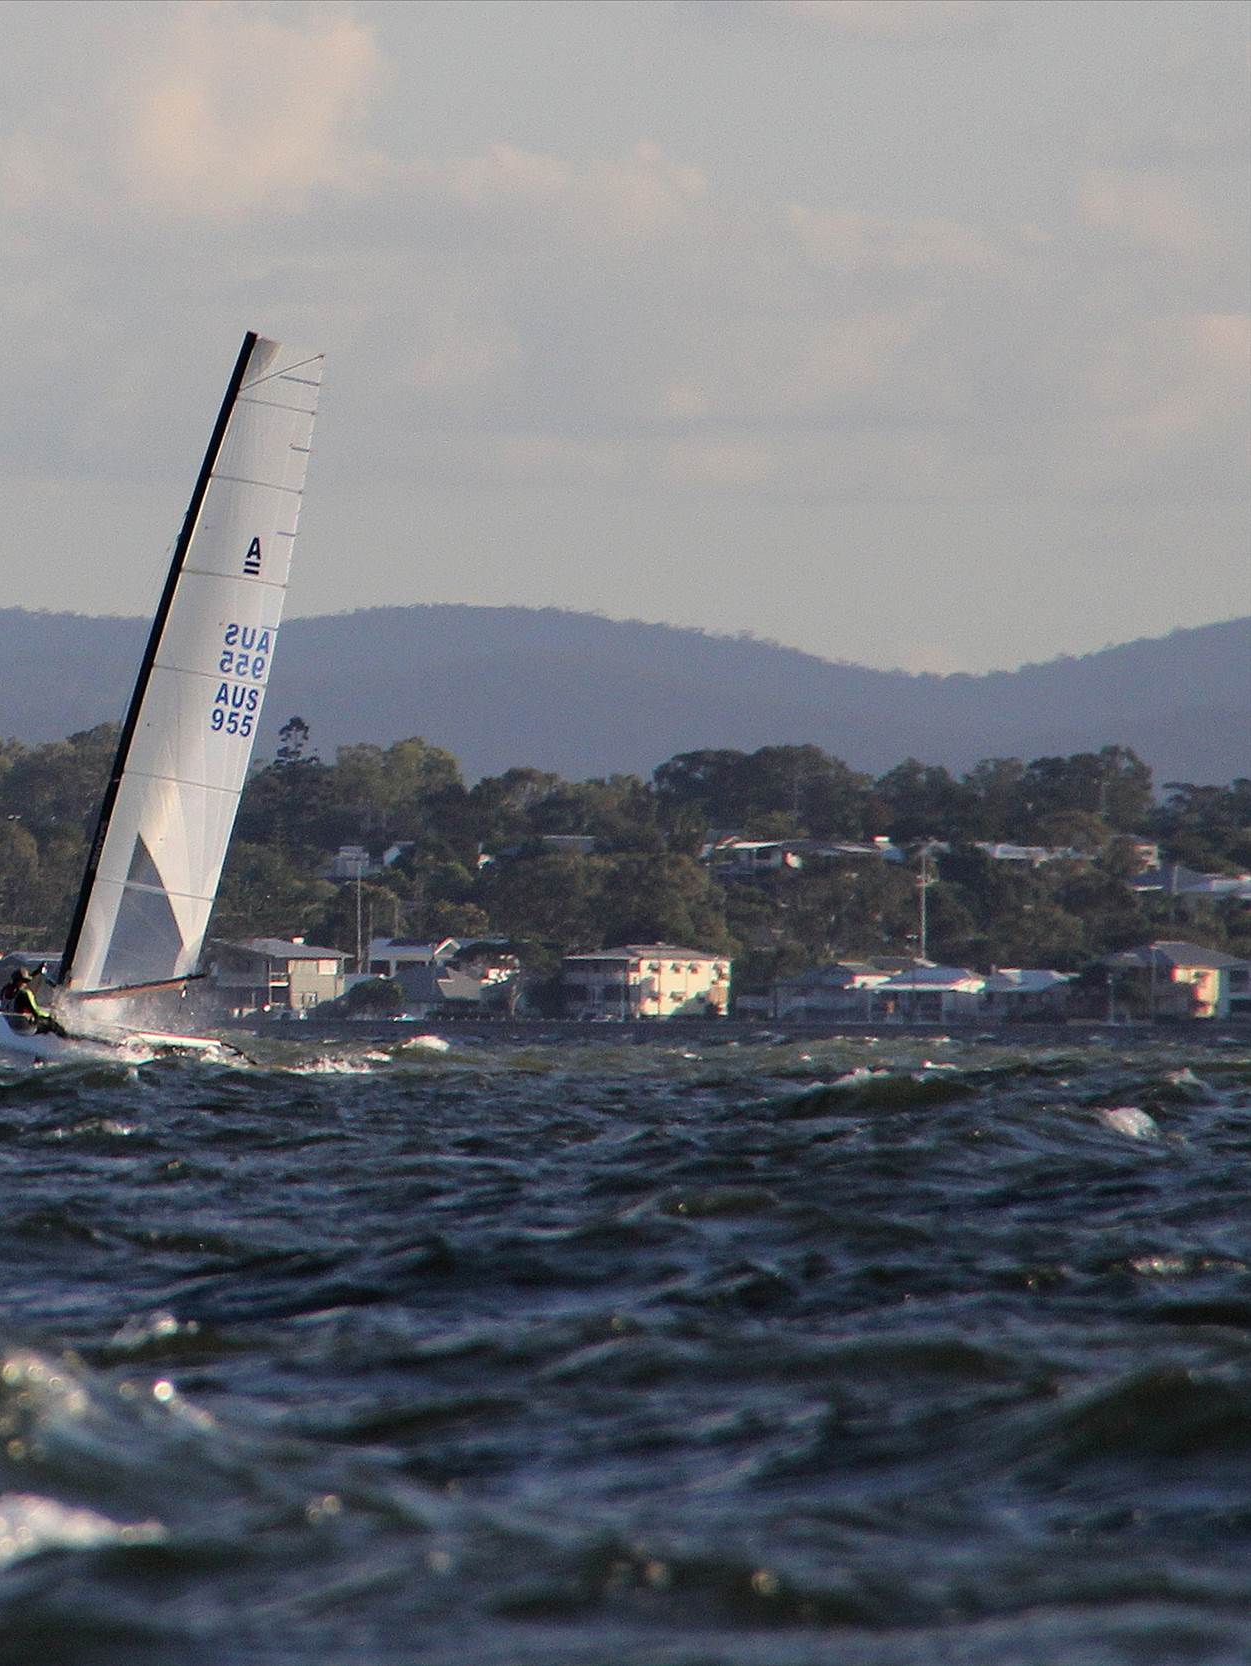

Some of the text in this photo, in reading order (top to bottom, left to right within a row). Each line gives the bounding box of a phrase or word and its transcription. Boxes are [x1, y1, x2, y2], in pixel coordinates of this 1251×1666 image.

[246, 537, 261, 560] A
[215, 683, 258, 711] AUS
[211, 709, 254, 737] 955
